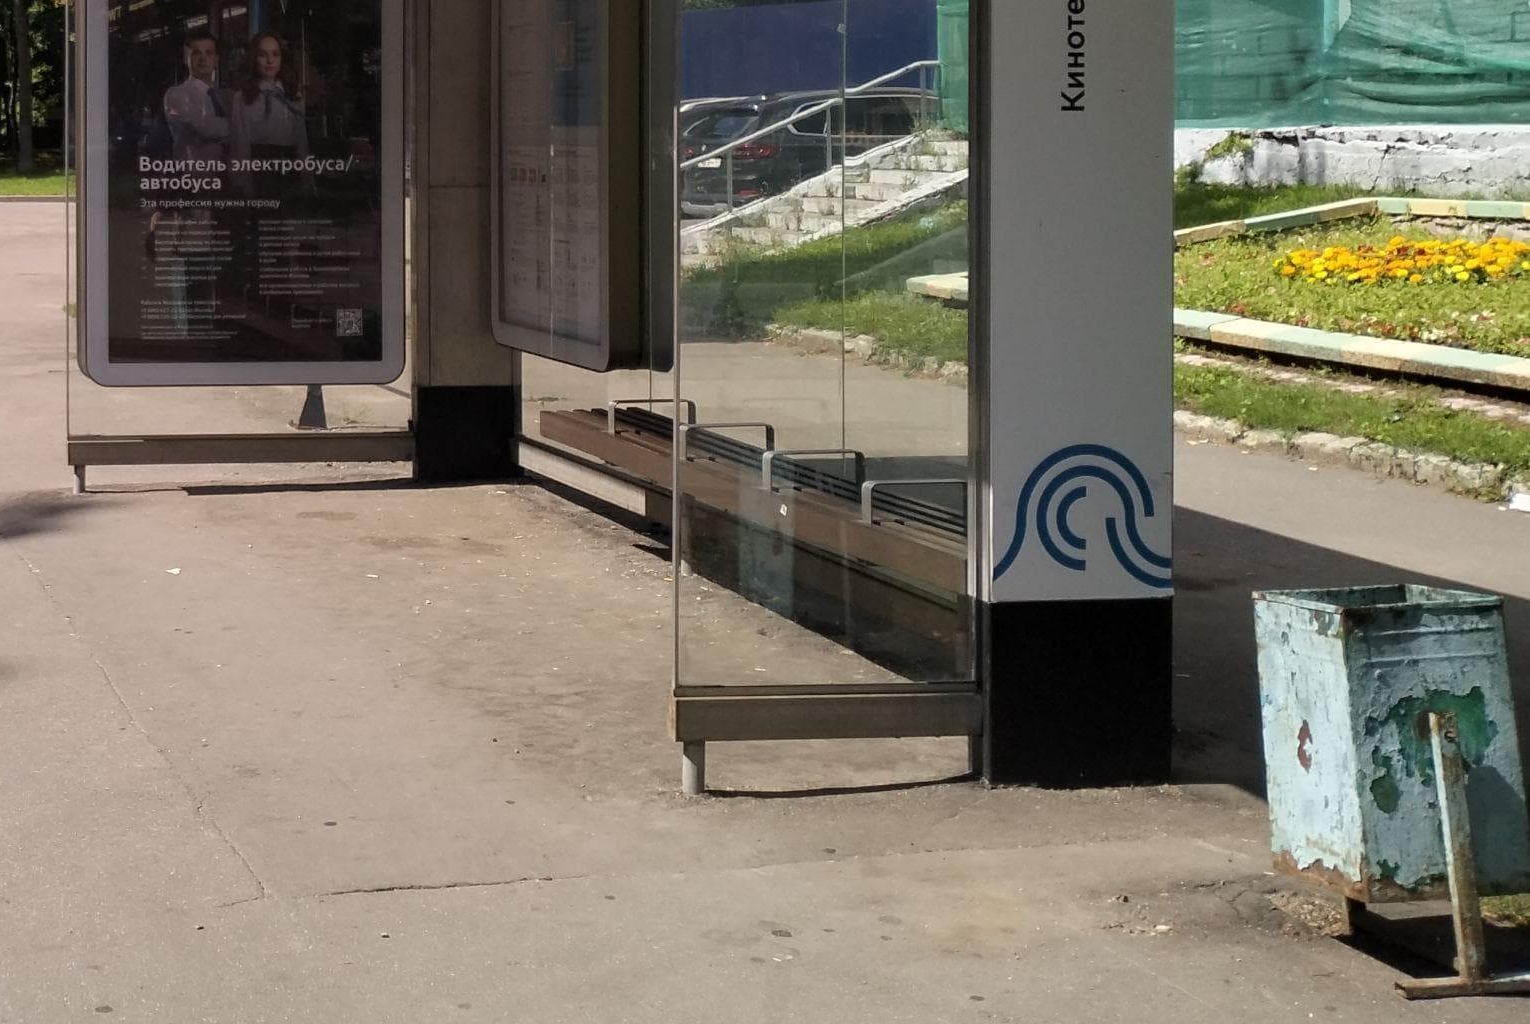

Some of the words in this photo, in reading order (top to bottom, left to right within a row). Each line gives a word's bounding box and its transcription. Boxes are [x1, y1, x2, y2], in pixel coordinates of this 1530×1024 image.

[139, 156, 226, 173] Водитель
[231, 154, 353, 175] электробуса/
[140, 174, 221, 193] автобуса
[140, 199, 157, 208] Эта
[159, 198, 212, 209] профессия
[214, 200, 245, 209] нужна
[247, 199, 281, 209] городу
